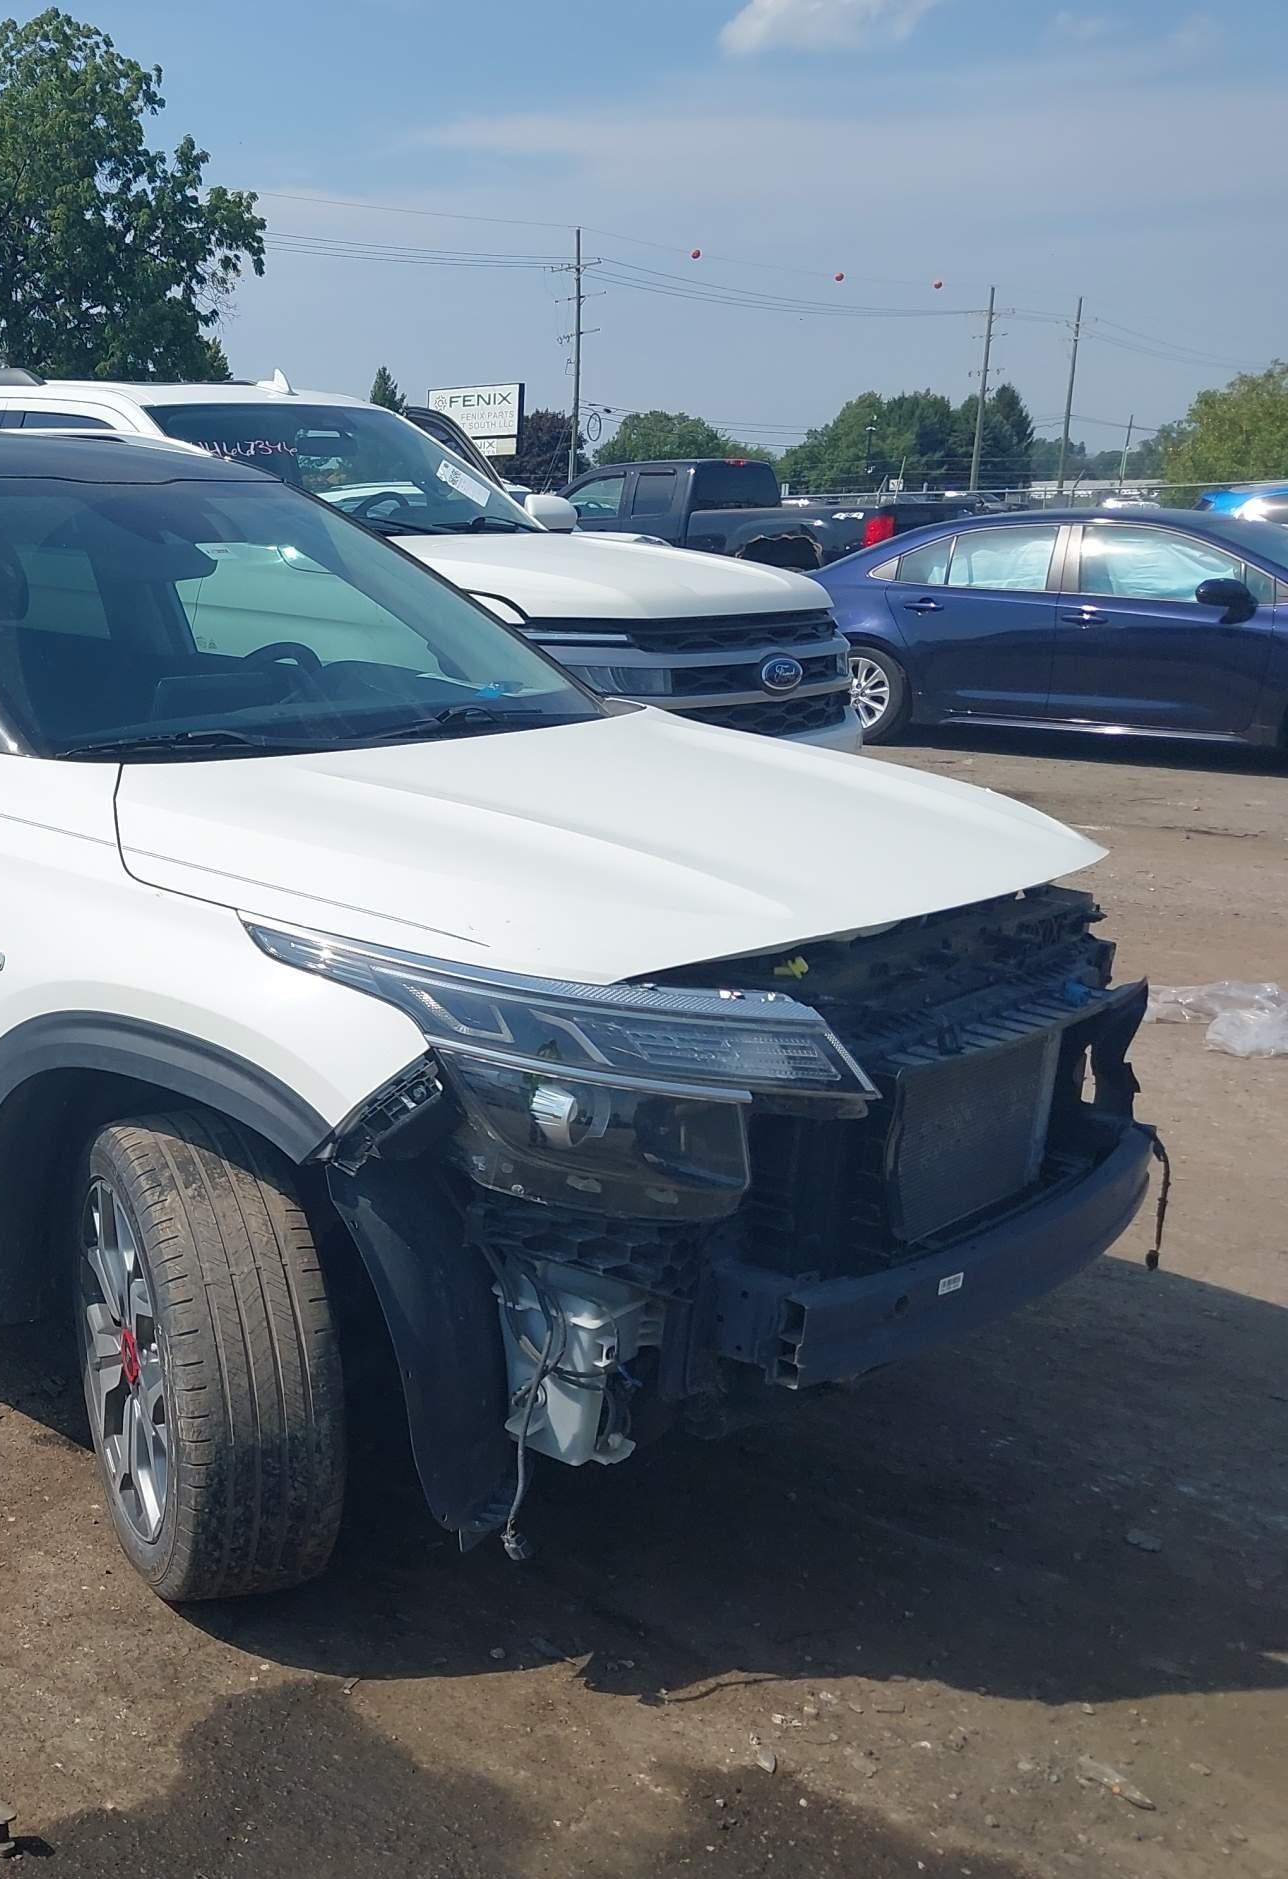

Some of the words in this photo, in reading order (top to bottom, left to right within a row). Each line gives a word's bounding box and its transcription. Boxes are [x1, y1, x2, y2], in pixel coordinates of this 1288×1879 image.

[449, 392, 512, 408] FENIX
[461, 412, 485, 421] FENIX
[487, 411, 515, 419] PARTS
[468, 421, 496, 430] SOUTH
[498, 419, 514, 428] LLC
[475, 441, 495, 449] NIX
